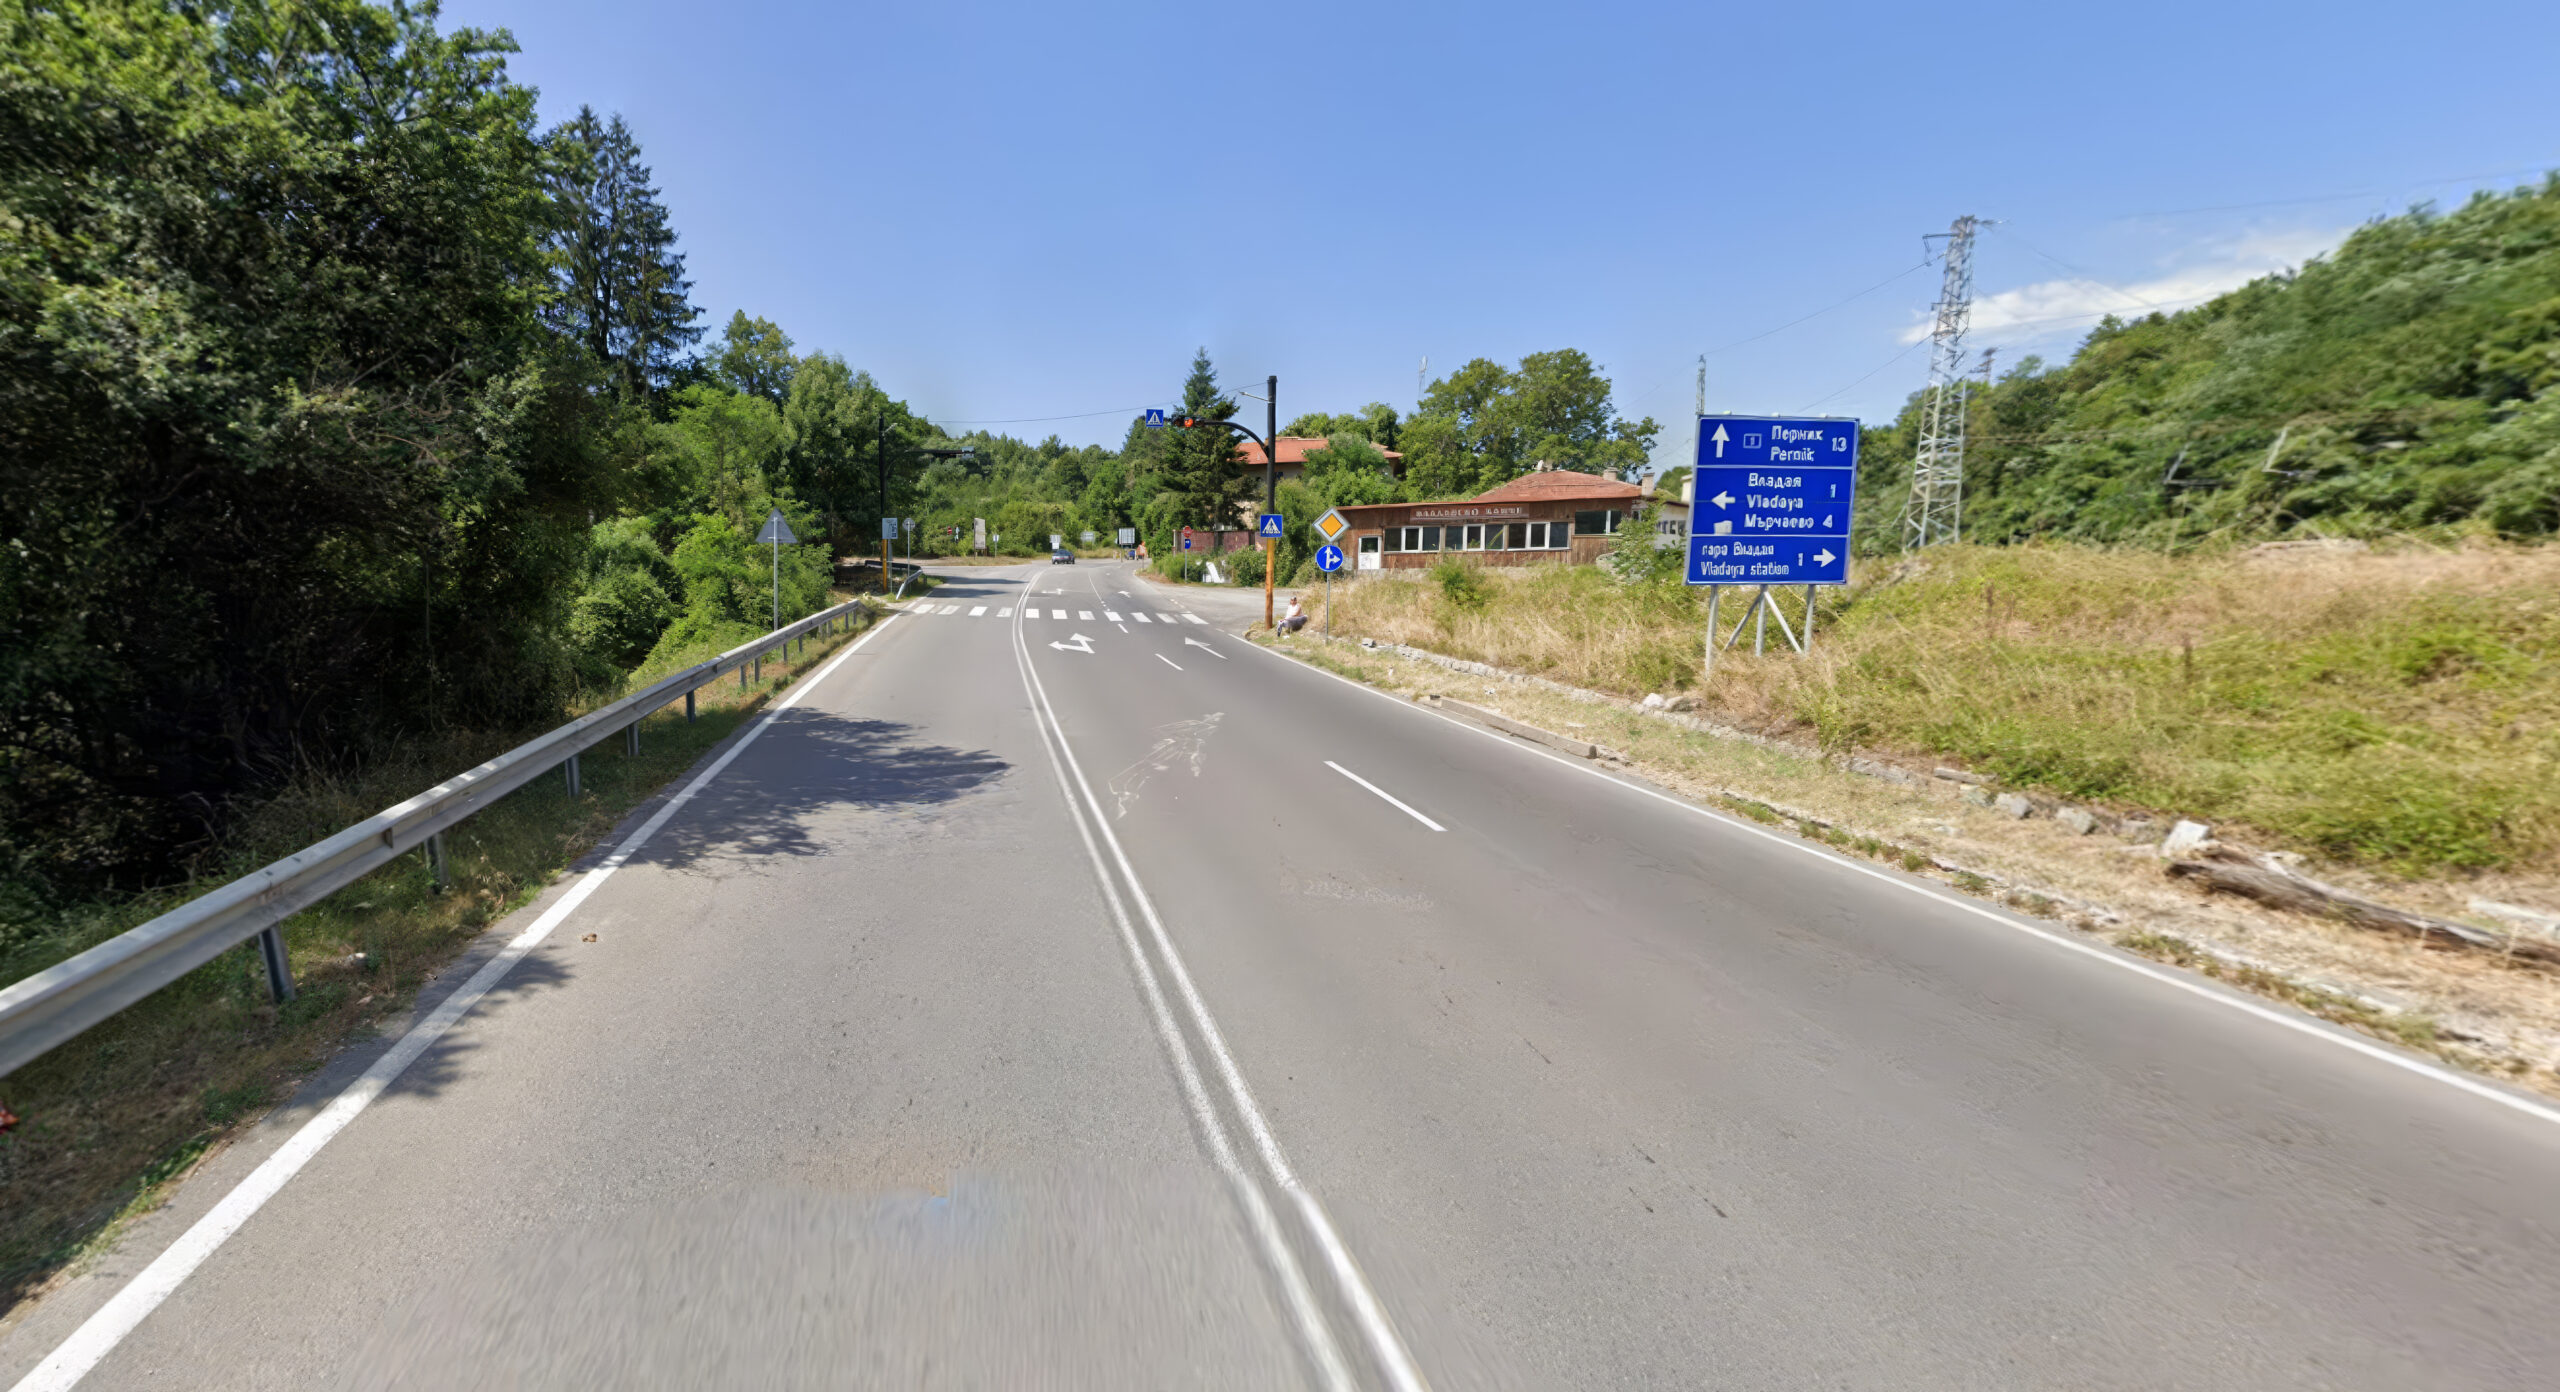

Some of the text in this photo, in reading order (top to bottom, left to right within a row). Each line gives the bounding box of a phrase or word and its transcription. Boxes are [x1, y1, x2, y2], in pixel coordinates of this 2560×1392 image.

[1772, 425, 1823, 443] Перник
[1832, 437, 1847, 452] 13
[1770, 446, 1815, 461] Pernik
[1748, 472, 1802, 489] Владая
[1830, 484, 1836, 498] 1
[1746, 494, 1803, 512] Vladaya
[1744, 514, 1833, 531] Мърчаево 4
[1702, 545, 1728, 558] гара
[1798, 553, 1804, 567] 1
[1701, 562, 1789, 578] Vladaya station
